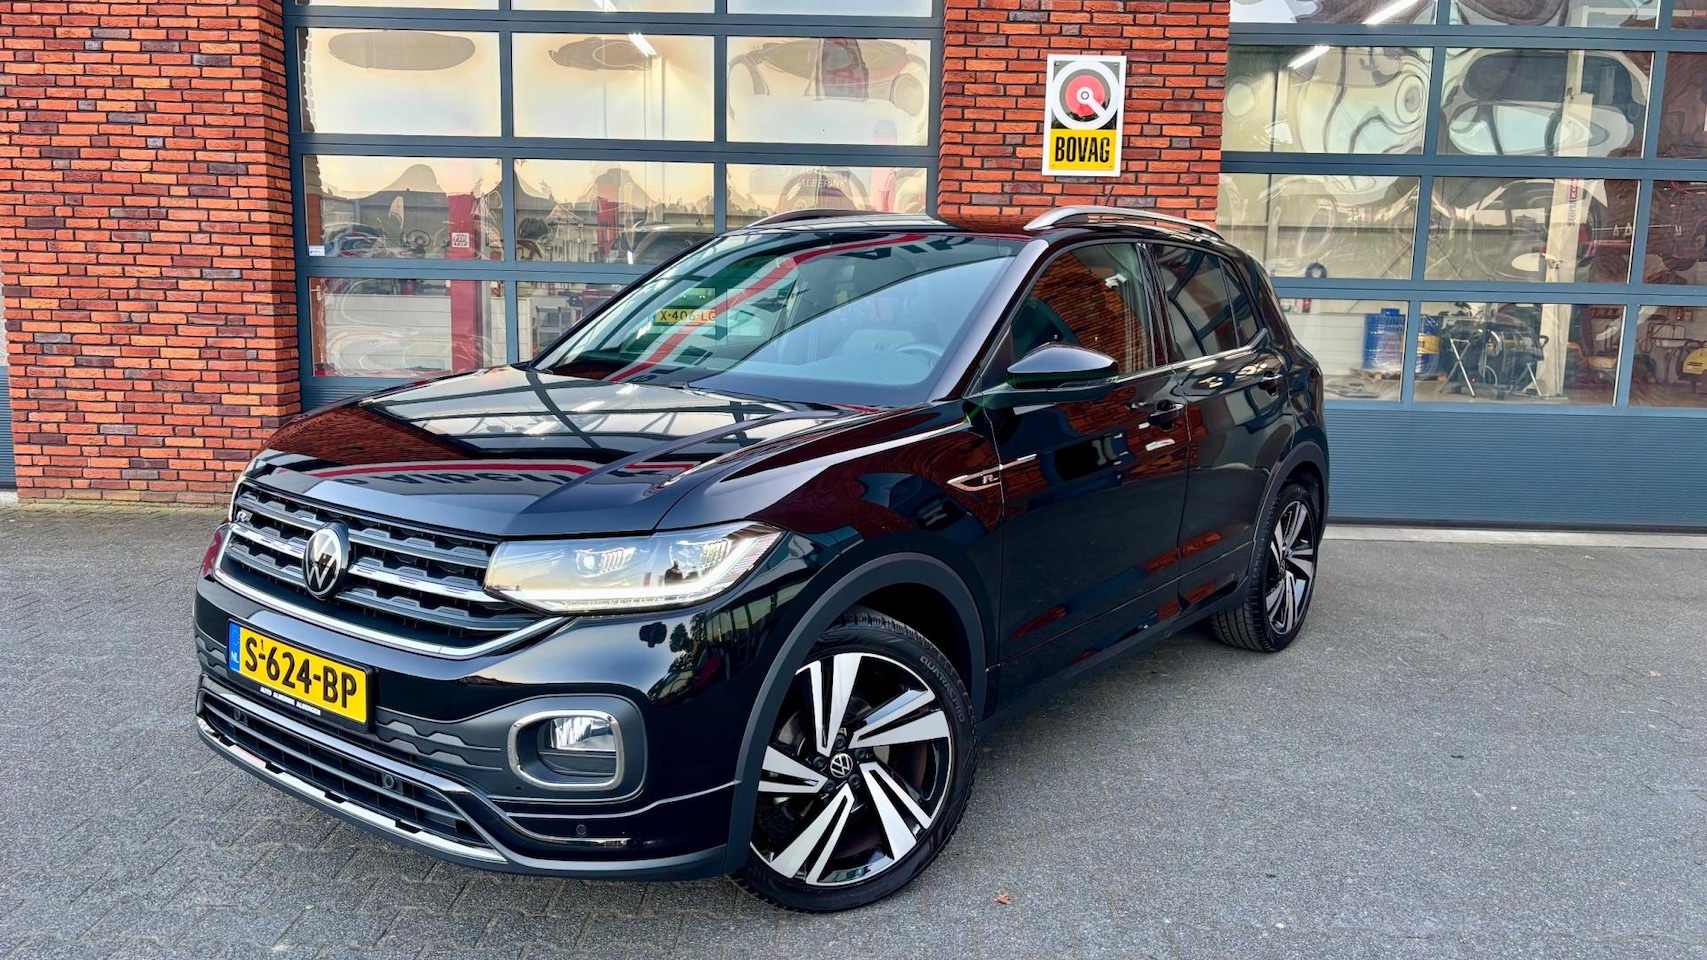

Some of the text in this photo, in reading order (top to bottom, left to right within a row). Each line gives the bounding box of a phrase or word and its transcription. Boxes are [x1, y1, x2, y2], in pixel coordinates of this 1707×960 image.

[1054, 136, 1110, 163] BOVAG
[230, 637, 357, 708] NL S-624-BP
